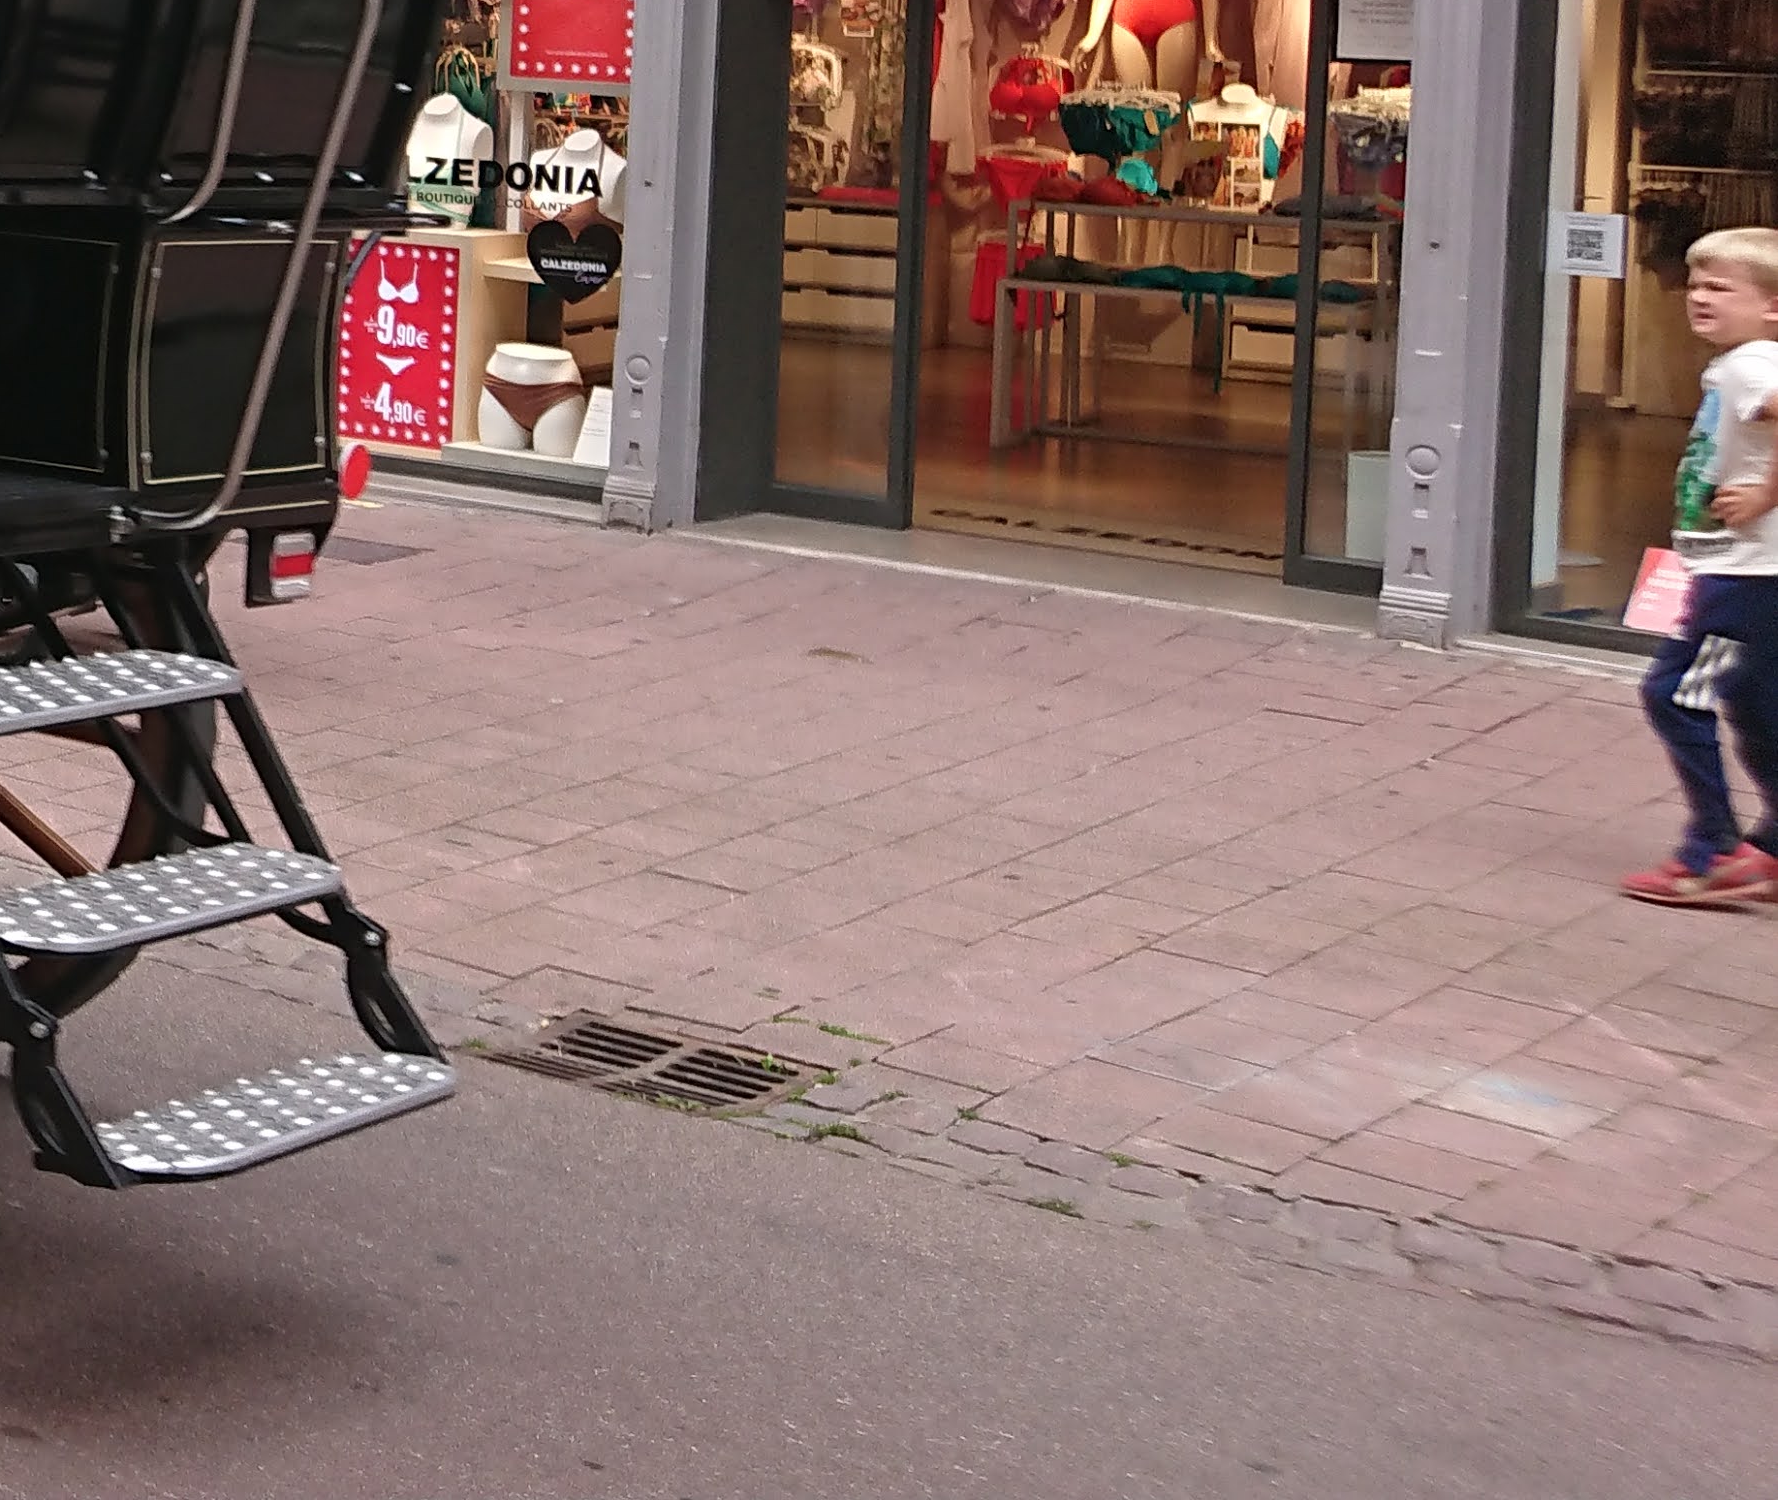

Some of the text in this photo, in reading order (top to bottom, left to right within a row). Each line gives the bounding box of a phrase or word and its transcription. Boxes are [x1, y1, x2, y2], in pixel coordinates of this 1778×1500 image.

[540, 257, 607, 273] CALZEDONIA
[376, 304, 430, 350] 9,90€
[374, 381, 427, 427] 4,90€
